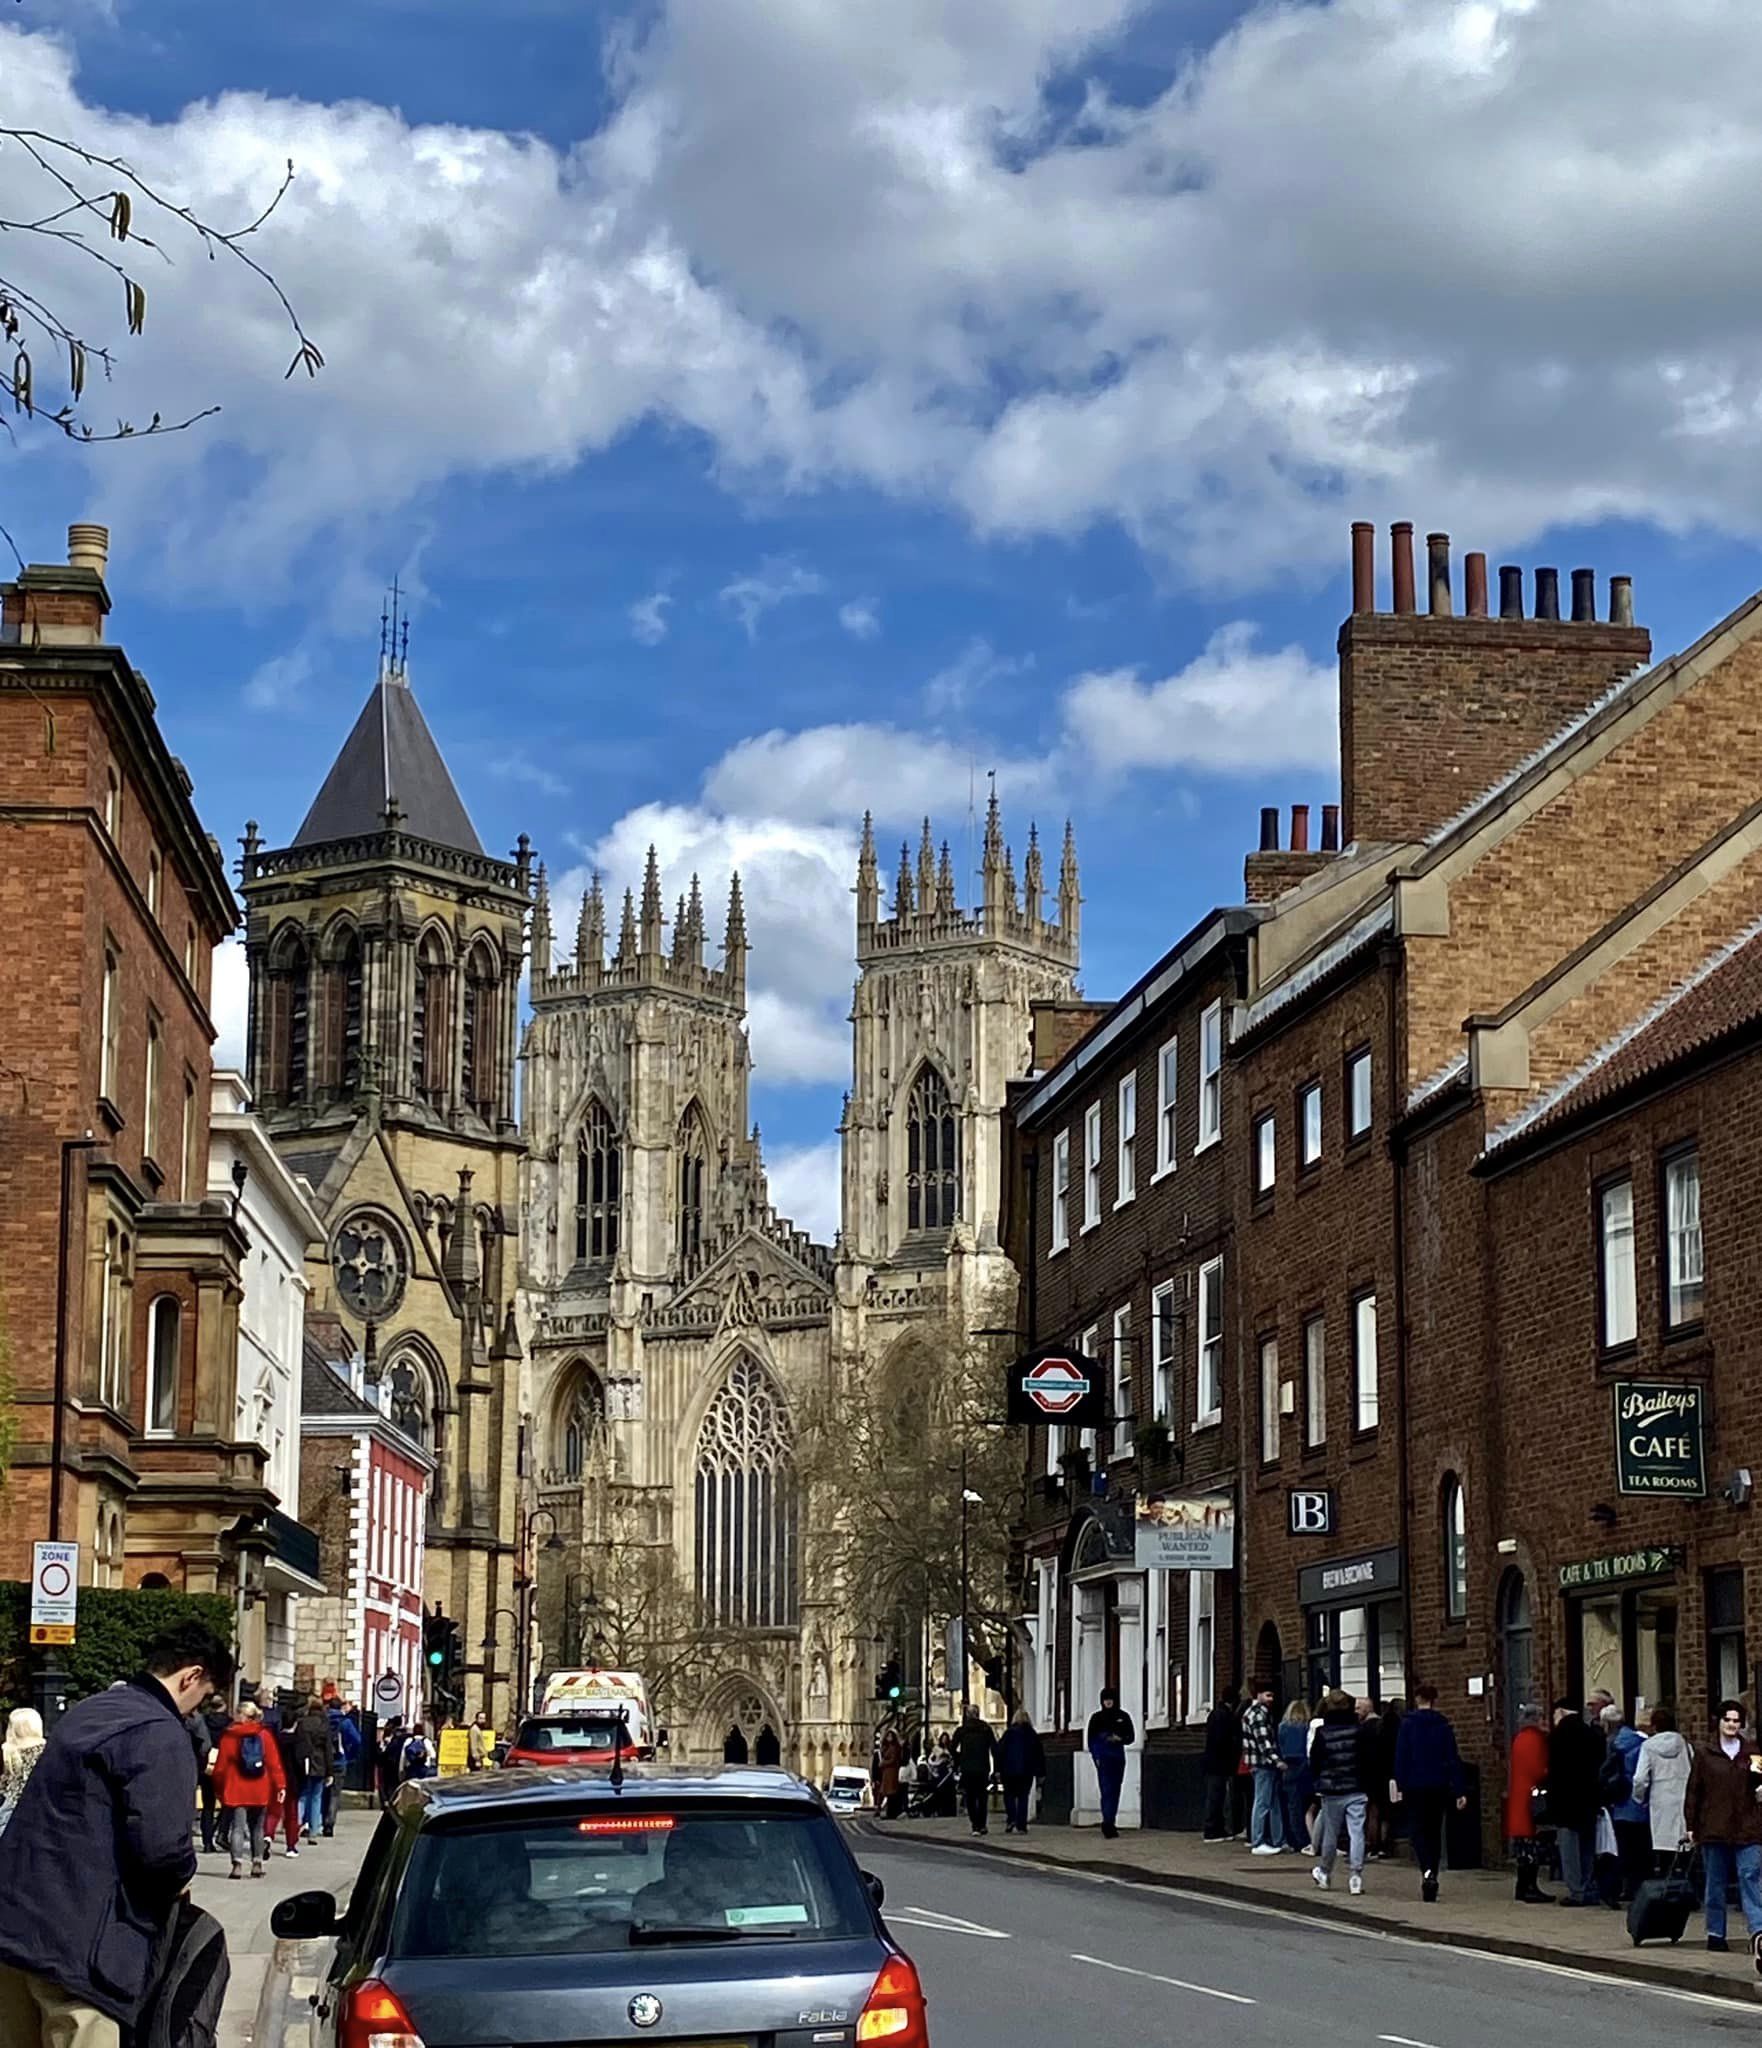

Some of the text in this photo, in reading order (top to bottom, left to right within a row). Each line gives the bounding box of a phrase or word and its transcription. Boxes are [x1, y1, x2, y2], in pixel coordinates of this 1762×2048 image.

[1622, 1390, 1696, 1419] Baileys
[1629, 1432, 1691, 1459] CAFÉ
[1628, 1475, 1698, 1489] TEA ROOMS
[1296, 1494, 1325, 1529] B
[1158, 1531, 1212, 1541] PUBLICAN
[1161, 1541, 1209, 1551] WANTED
[41, 1551, 70, 1561] ZONE
[1593, 1560, 1610, 1579] TEA
[1613, 1551, 1647, 1576] ROOMS
